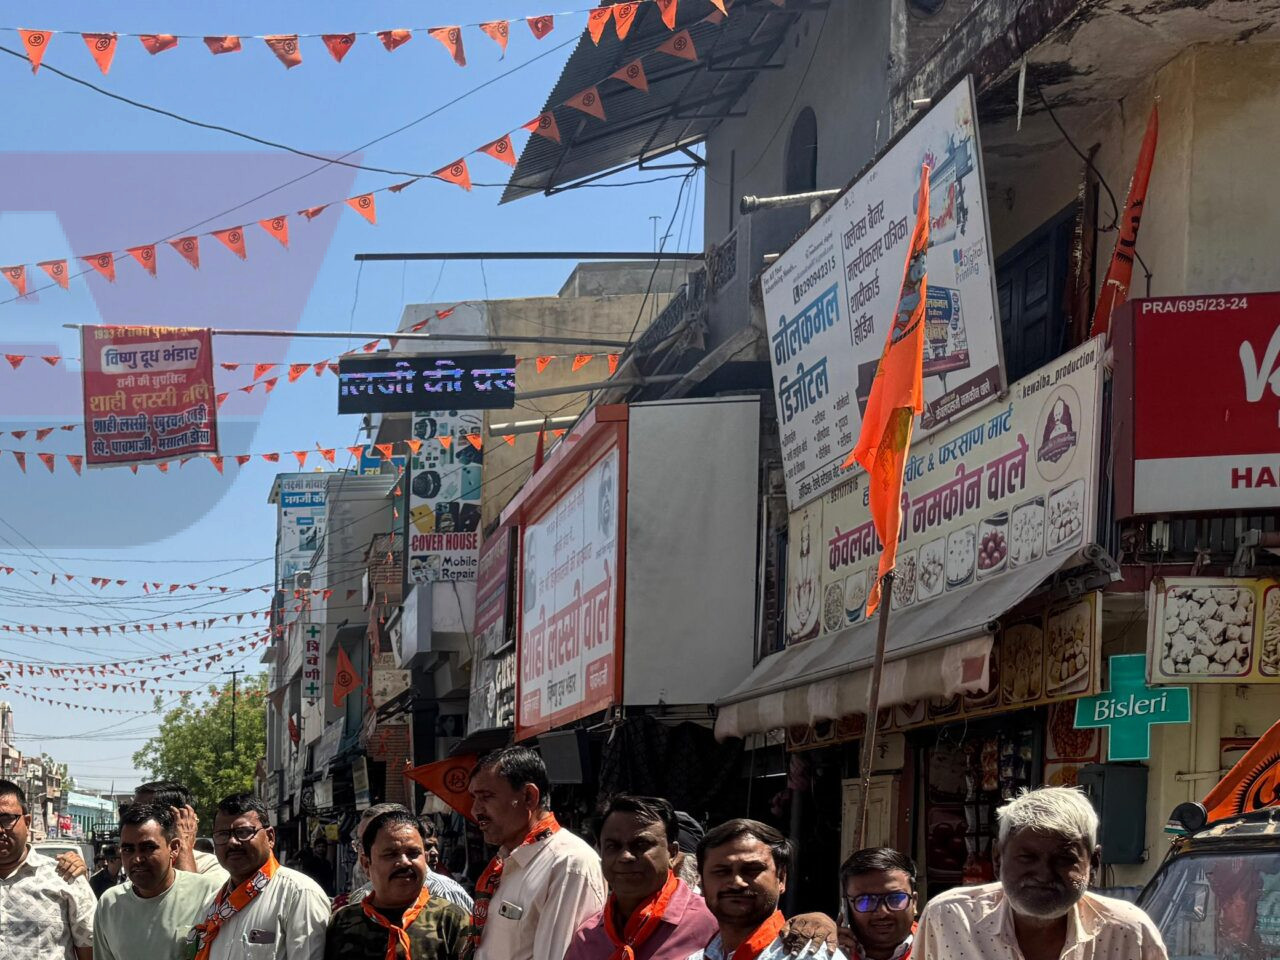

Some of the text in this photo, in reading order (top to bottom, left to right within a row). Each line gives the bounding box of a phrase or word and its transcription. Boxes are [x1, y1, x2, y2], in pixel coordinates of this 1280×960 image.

[868, 200, 885, 229] बैनर
[883, 216, 909, 251] पत्रिका
[955, 261, 980, 285] Printing
[850, 268, 880, 314] शादीकार्ड
[1141, 296, 1249, 315] PRA/695/23-24
[771, 281, 841, 366] नीलकमल
[104, 345, 199, 369] विष्णु दूध भंडार
[1238, 323, 1280, 403] V
[1022, 350, 1095, 400] kewalba_production
[89, 390, 126, 413] शाही
[131, 386, 178, 411] लस्सी
[778, 356, 830, 426] डिजीटल
[987, 402, 1014, 440] मार्ट
[912, 462, 985, 534] नमकीन
[986, 432, 1030, 500] वाले
[1230, 465, 1280, 489] HA
[411, 533, 478, 552] COVER HOUSE
[441, 556, 478, 569] Mobile
[441, 568, 475, 582] Repair
[523, 604, 547, 684] शाही
[546, 578, 582, 672] लस्सी
[582, 558, 613, 652] वाले
[1094, 692, 1168, 722] Bisleri
